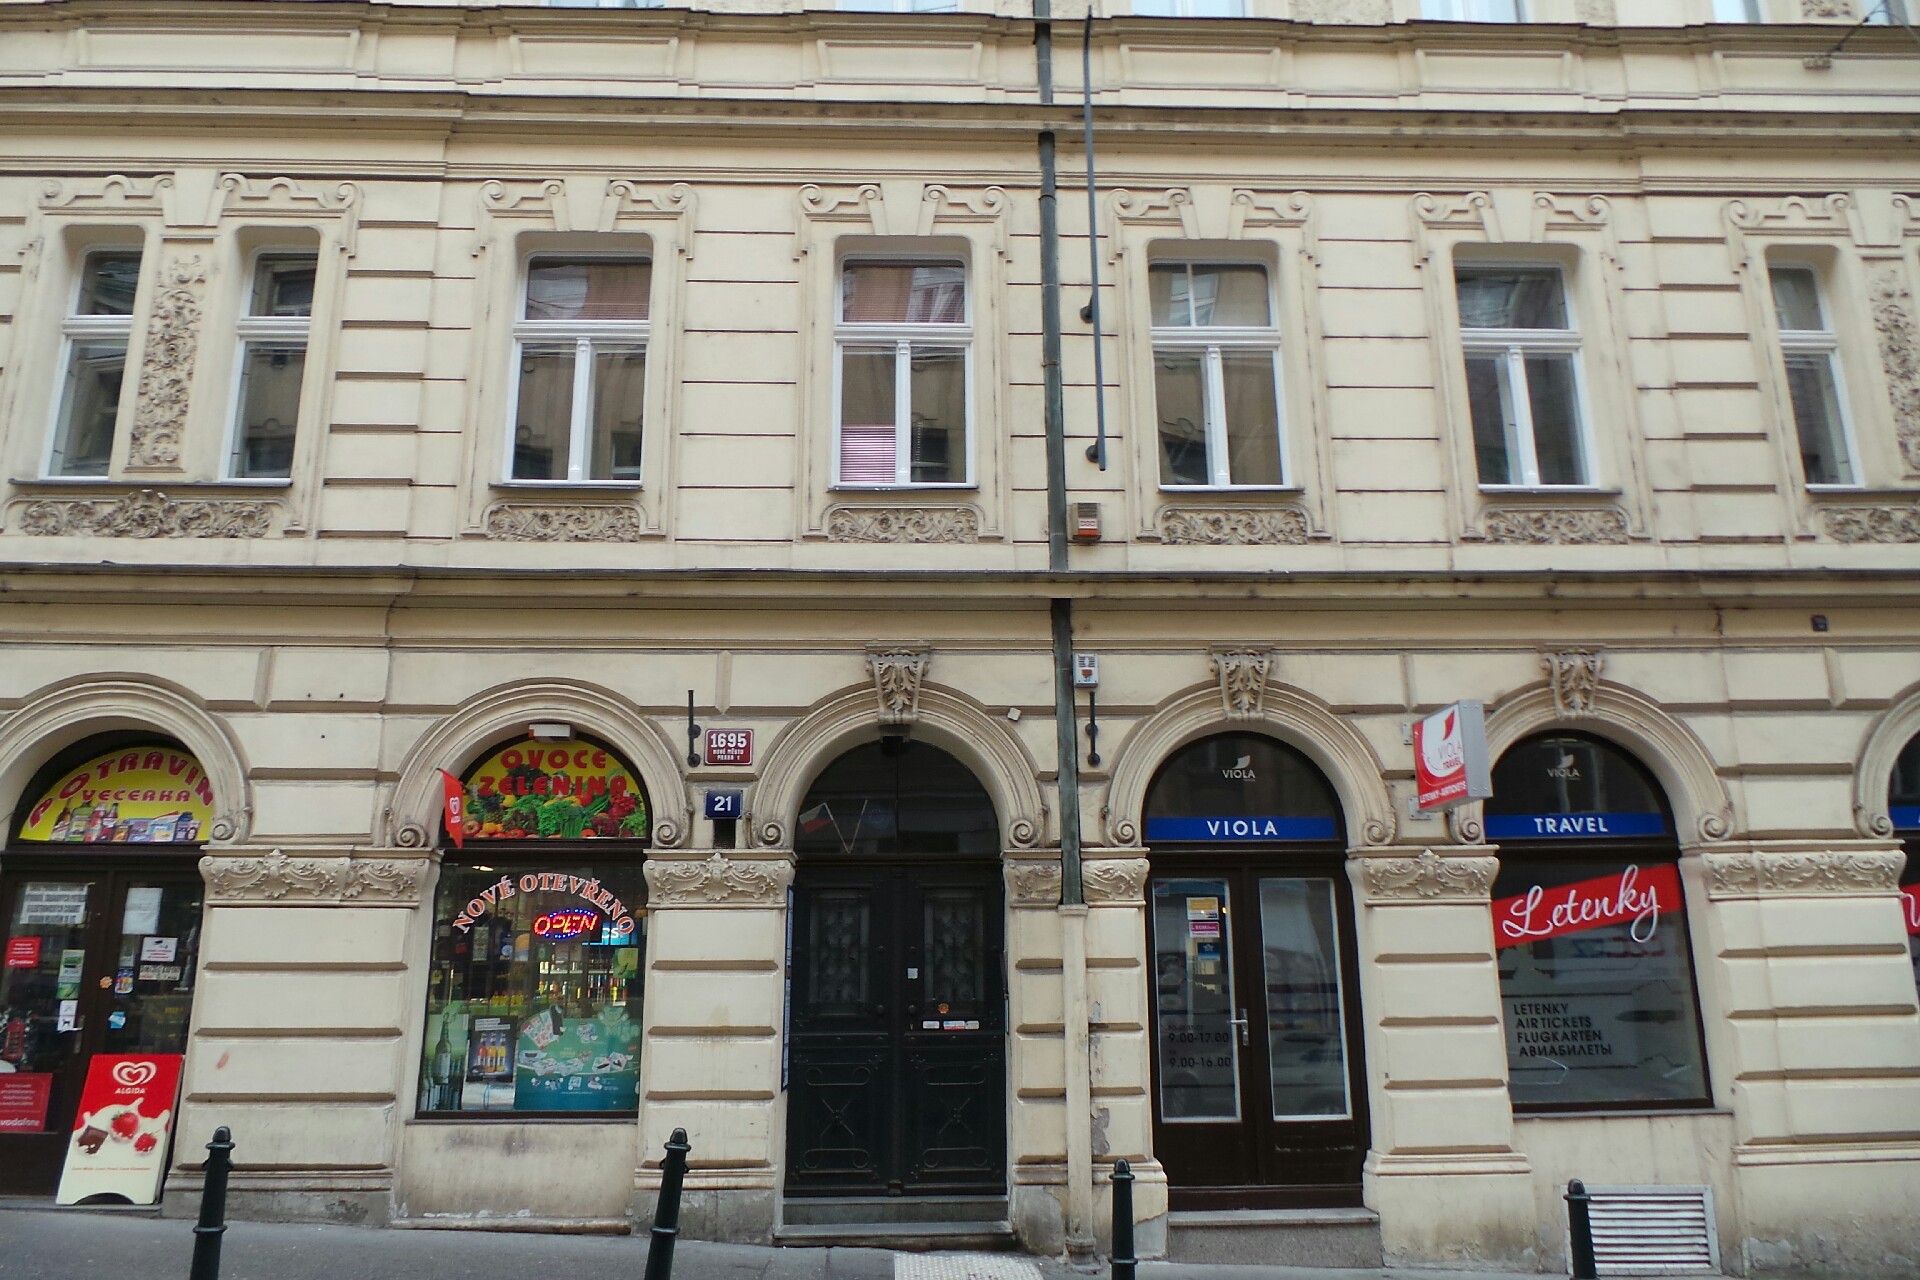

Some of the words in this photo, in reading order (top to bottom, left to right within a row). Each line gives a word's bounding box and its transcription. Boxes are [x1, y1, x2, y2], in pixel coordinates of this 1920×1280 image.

[711, 733, 747, 748] 1695
[500, 750, 608, 769] OVOCE
[1222, 770, 1256, 779] VIOLA
[1547, 768, 1580, 777] VIOLA
[83, 786, 191, 802] VEČERKA
[477, 775, 628, 797] ZELENINA
[714, 795, 732, 811] 21
[1207, 820, 1278, 836] VIOLA
[1534, 817, 1608, 833] TRAVEL
[452, 875, 515, 934] NOVÉ
[519, 872, 635, 935] OTEVŘENO
[1502, 864, 1662, 944] Letenky
[534, 912, 599, 936] OPEN
[1513, 1002, 1569, 1016] LETENKY
[1517, 1030, 1602, 1043] FLUGKARTEN
[1518, 1043, 1613, 1057] АВИАБИЛЕТЫ
